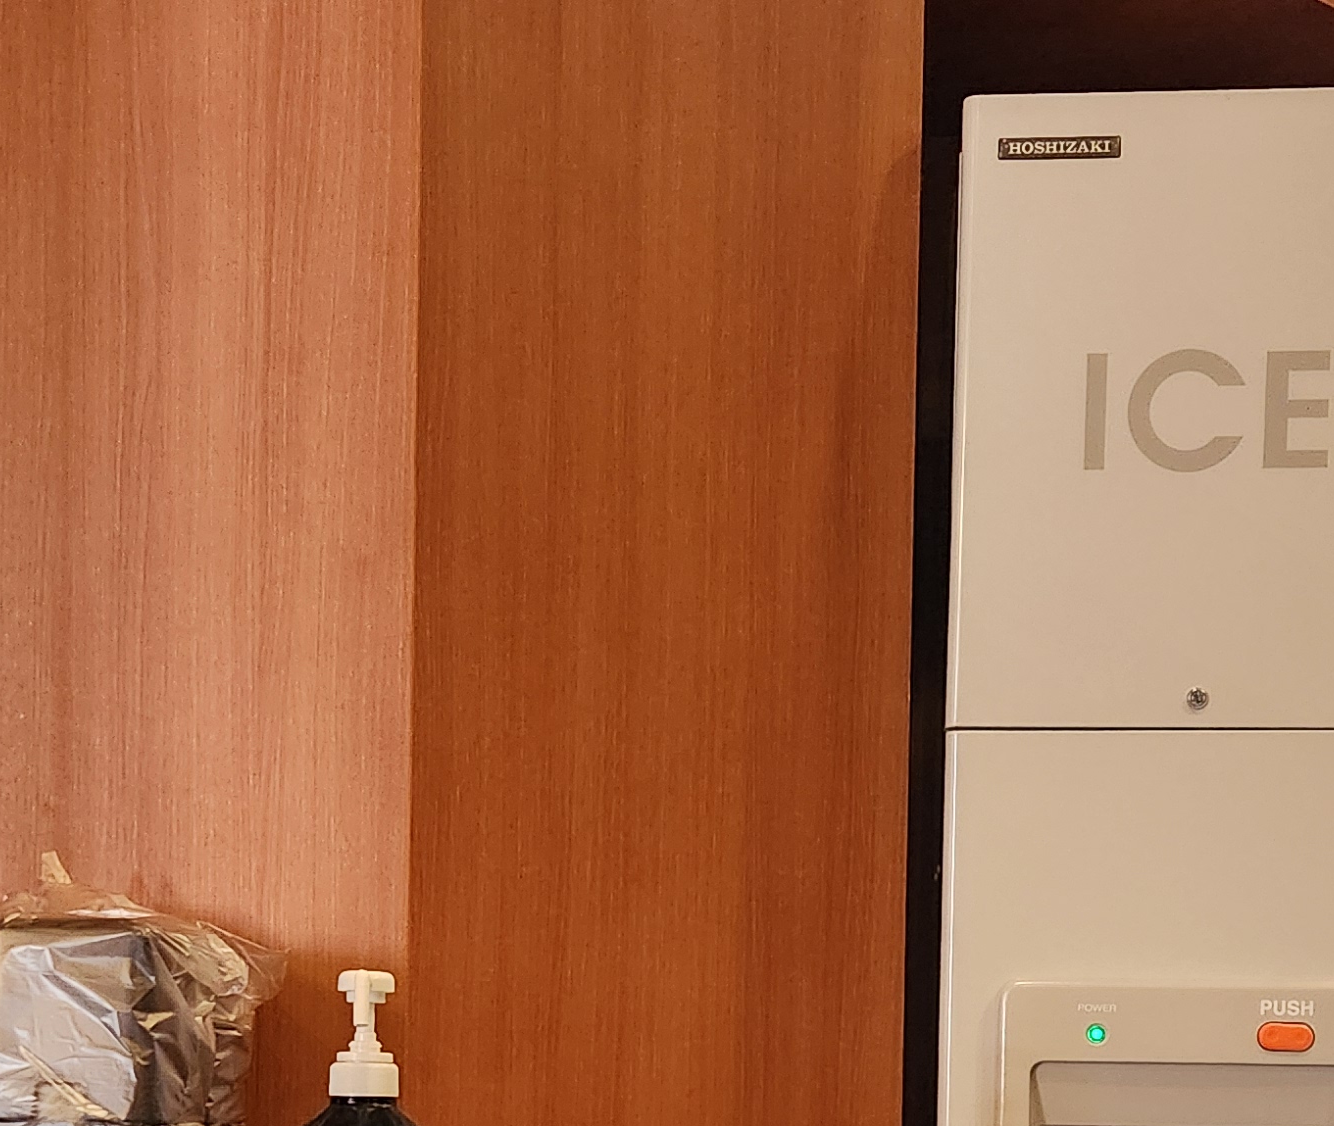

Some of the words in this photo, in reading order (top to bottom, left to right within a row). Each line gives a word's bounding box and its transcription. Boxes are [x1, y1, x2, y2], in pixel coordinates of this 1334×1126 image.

[1007, 139, 1112, 156] HOSHIZAKI
[1083, 348, 1332, 473] ICE
[1077, 1003, 1117, 1014] POWER
[1259, 999, 1315, 1017] PUSH
